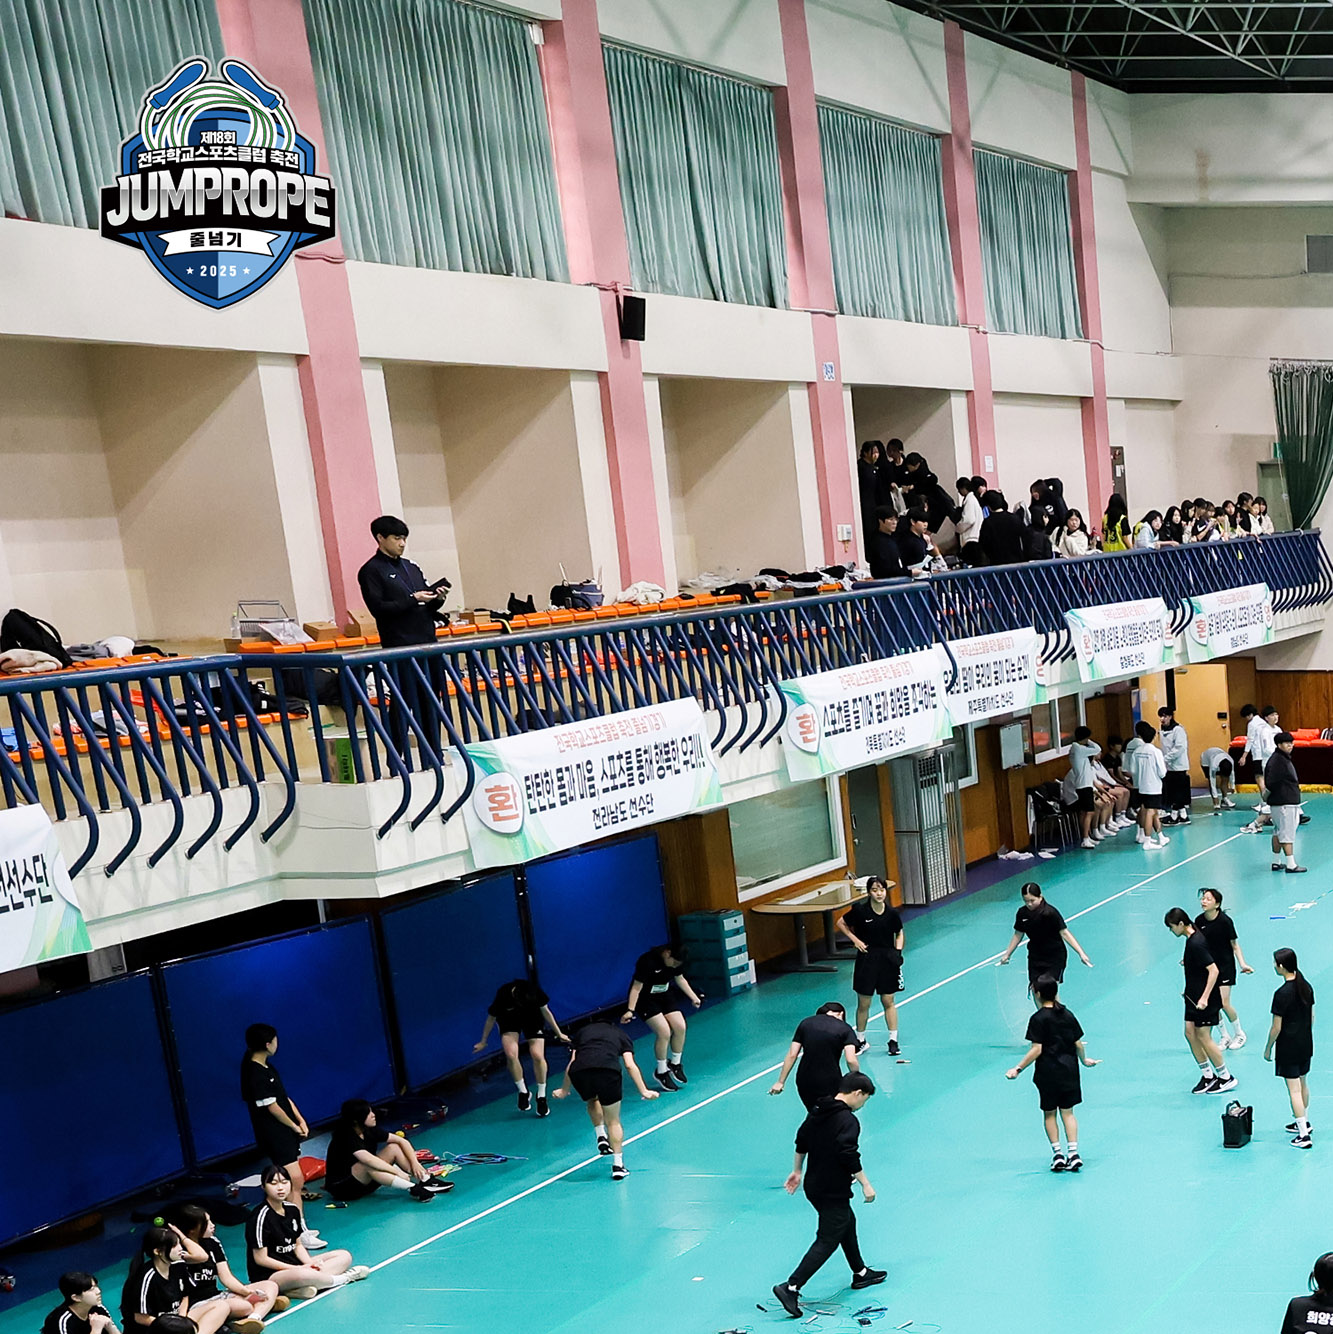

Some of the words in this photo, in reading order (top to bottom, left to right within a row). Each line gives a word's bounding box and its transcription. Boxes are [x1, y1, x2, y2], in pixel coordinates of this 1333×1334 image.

[823, 700, 852, 737] 스포츠를
[852, 695, 874, 730] 즐기며
[874, 690, 889, 724] 꿈과
[890, 686, 910, 719] 희망을
[911, 680, 937, 713] 조각하는
[524, 771, 557, 815] 탄탄한
[557, 765, 576, 806] 몸과
[576, 759, 600, 802] 마음,
[600, 748, 635, 794] 스포츠를
[636, 744, 655, 785] 통해
[655, 737, 681, 780] 행복한
[484, 784, 519, 823] 환
[592, 800, 629, 830] 전라남도
[629, 793, 655, 820] 선수단
